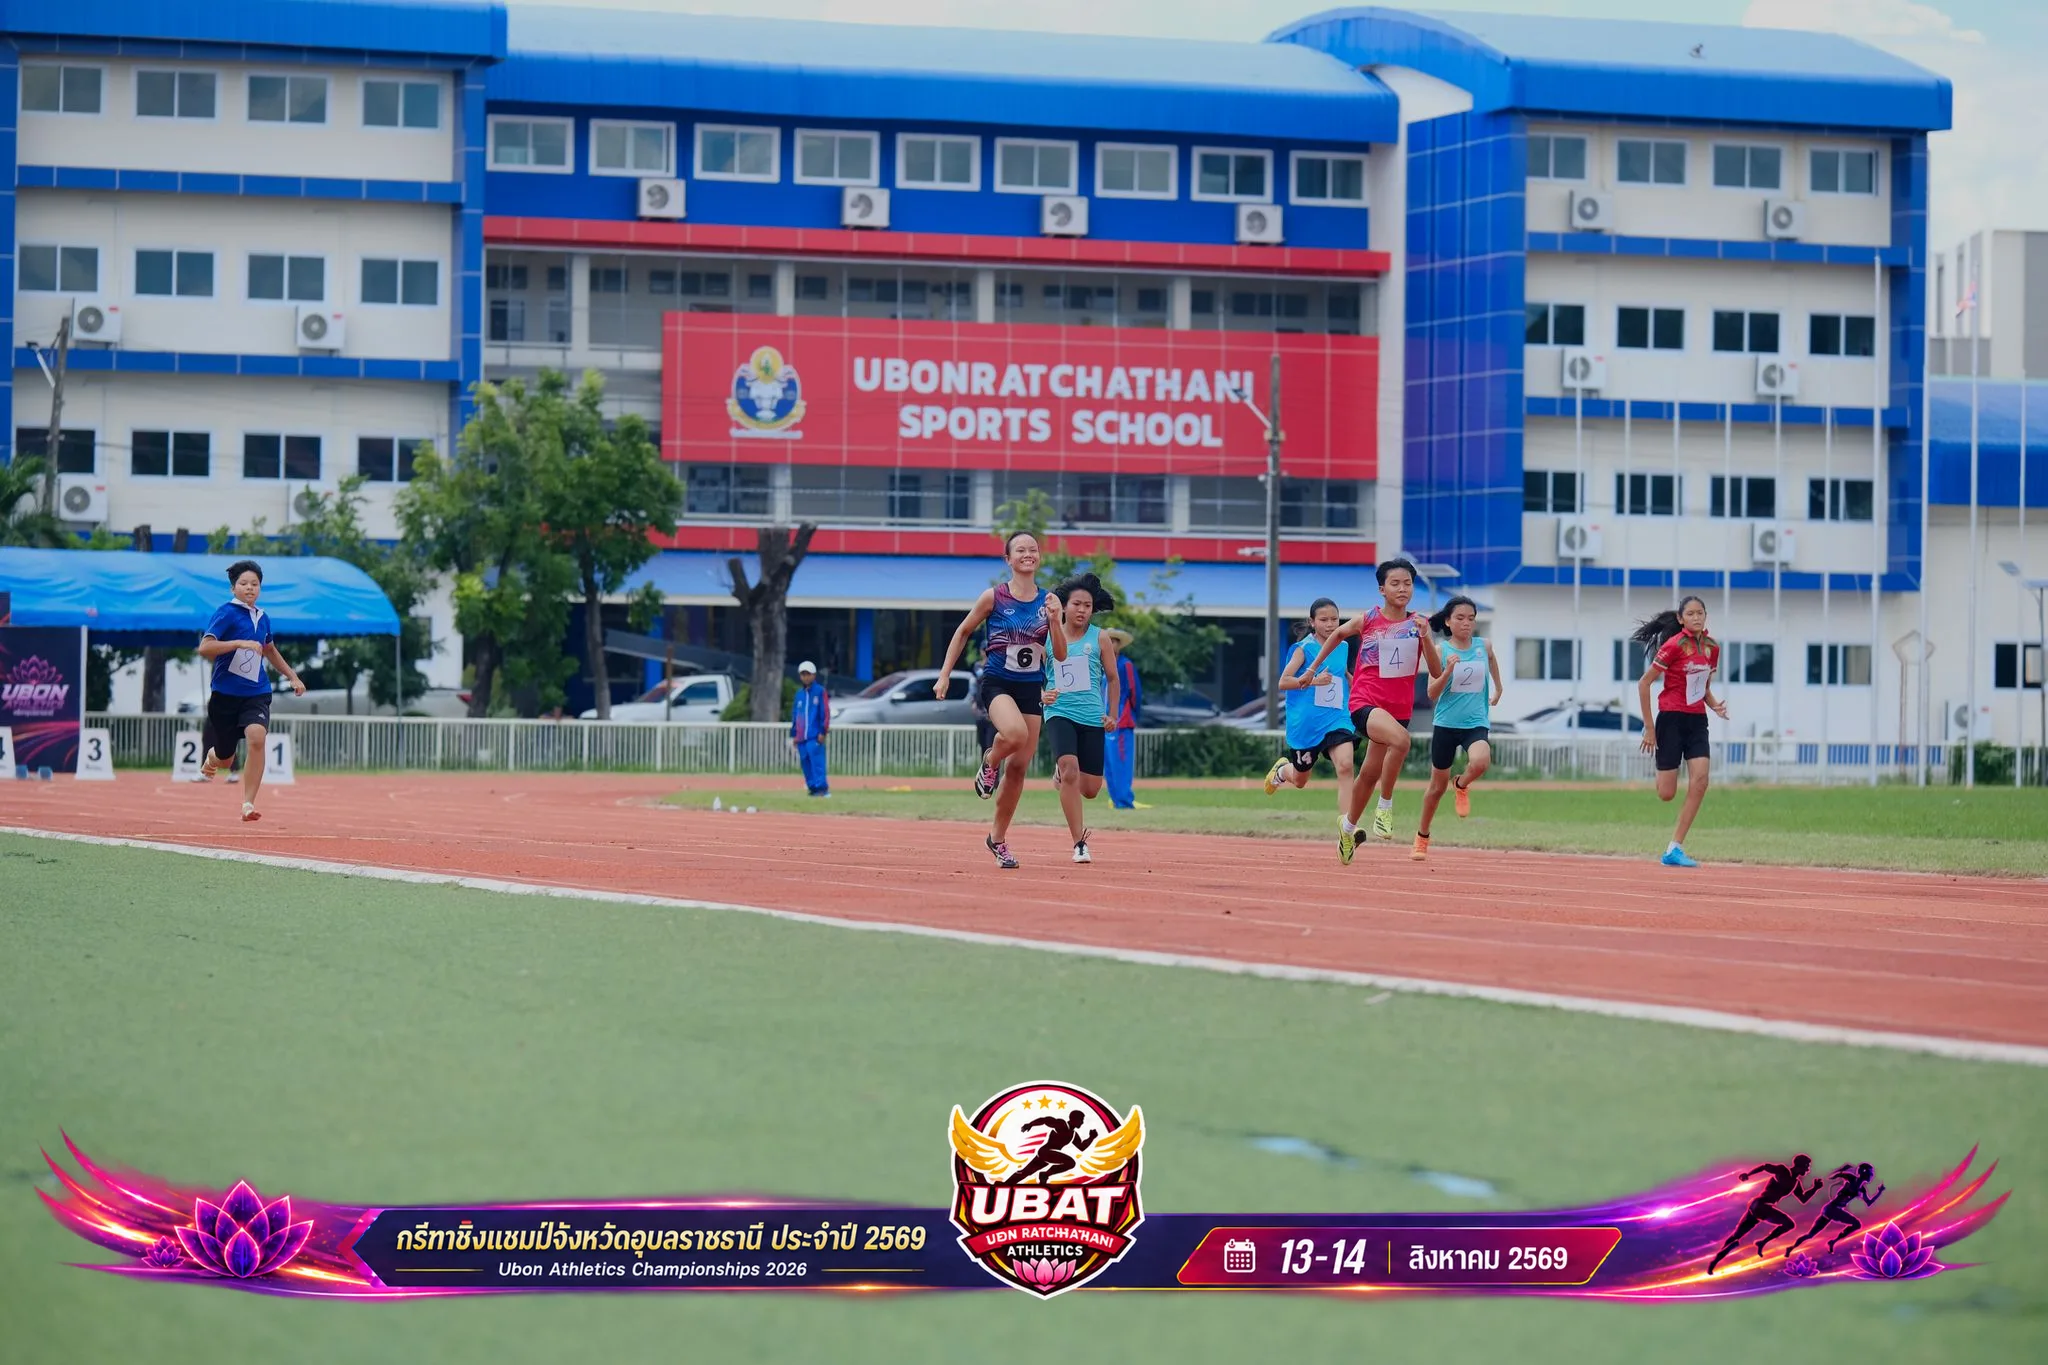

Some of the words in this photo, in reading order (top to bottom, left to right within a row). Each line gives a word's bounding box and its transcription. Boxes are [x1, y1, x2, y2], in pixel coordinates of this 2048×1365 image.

[853, 357, 1255, 403] UBONRATCHATHANI
[898, 405, 1051, 442] SPORTS
[1072, 409, 1223, 448] SCHOOL
[1017, 648, 1033, 667] 6
[1389, 646, 1404, 669] 4
[1061, 664, 1074, 687] 5
[1459, 667, 1473, 685] 2
[1, 684, 69, 701] UBON
[1326, 682, 1337, 702] 3
[87, 738, 102, 761] 3
[182, 742, 196, 763] 2
[272, 742, 283, 766] 1
[1295, 749, 1313, 766] 14
